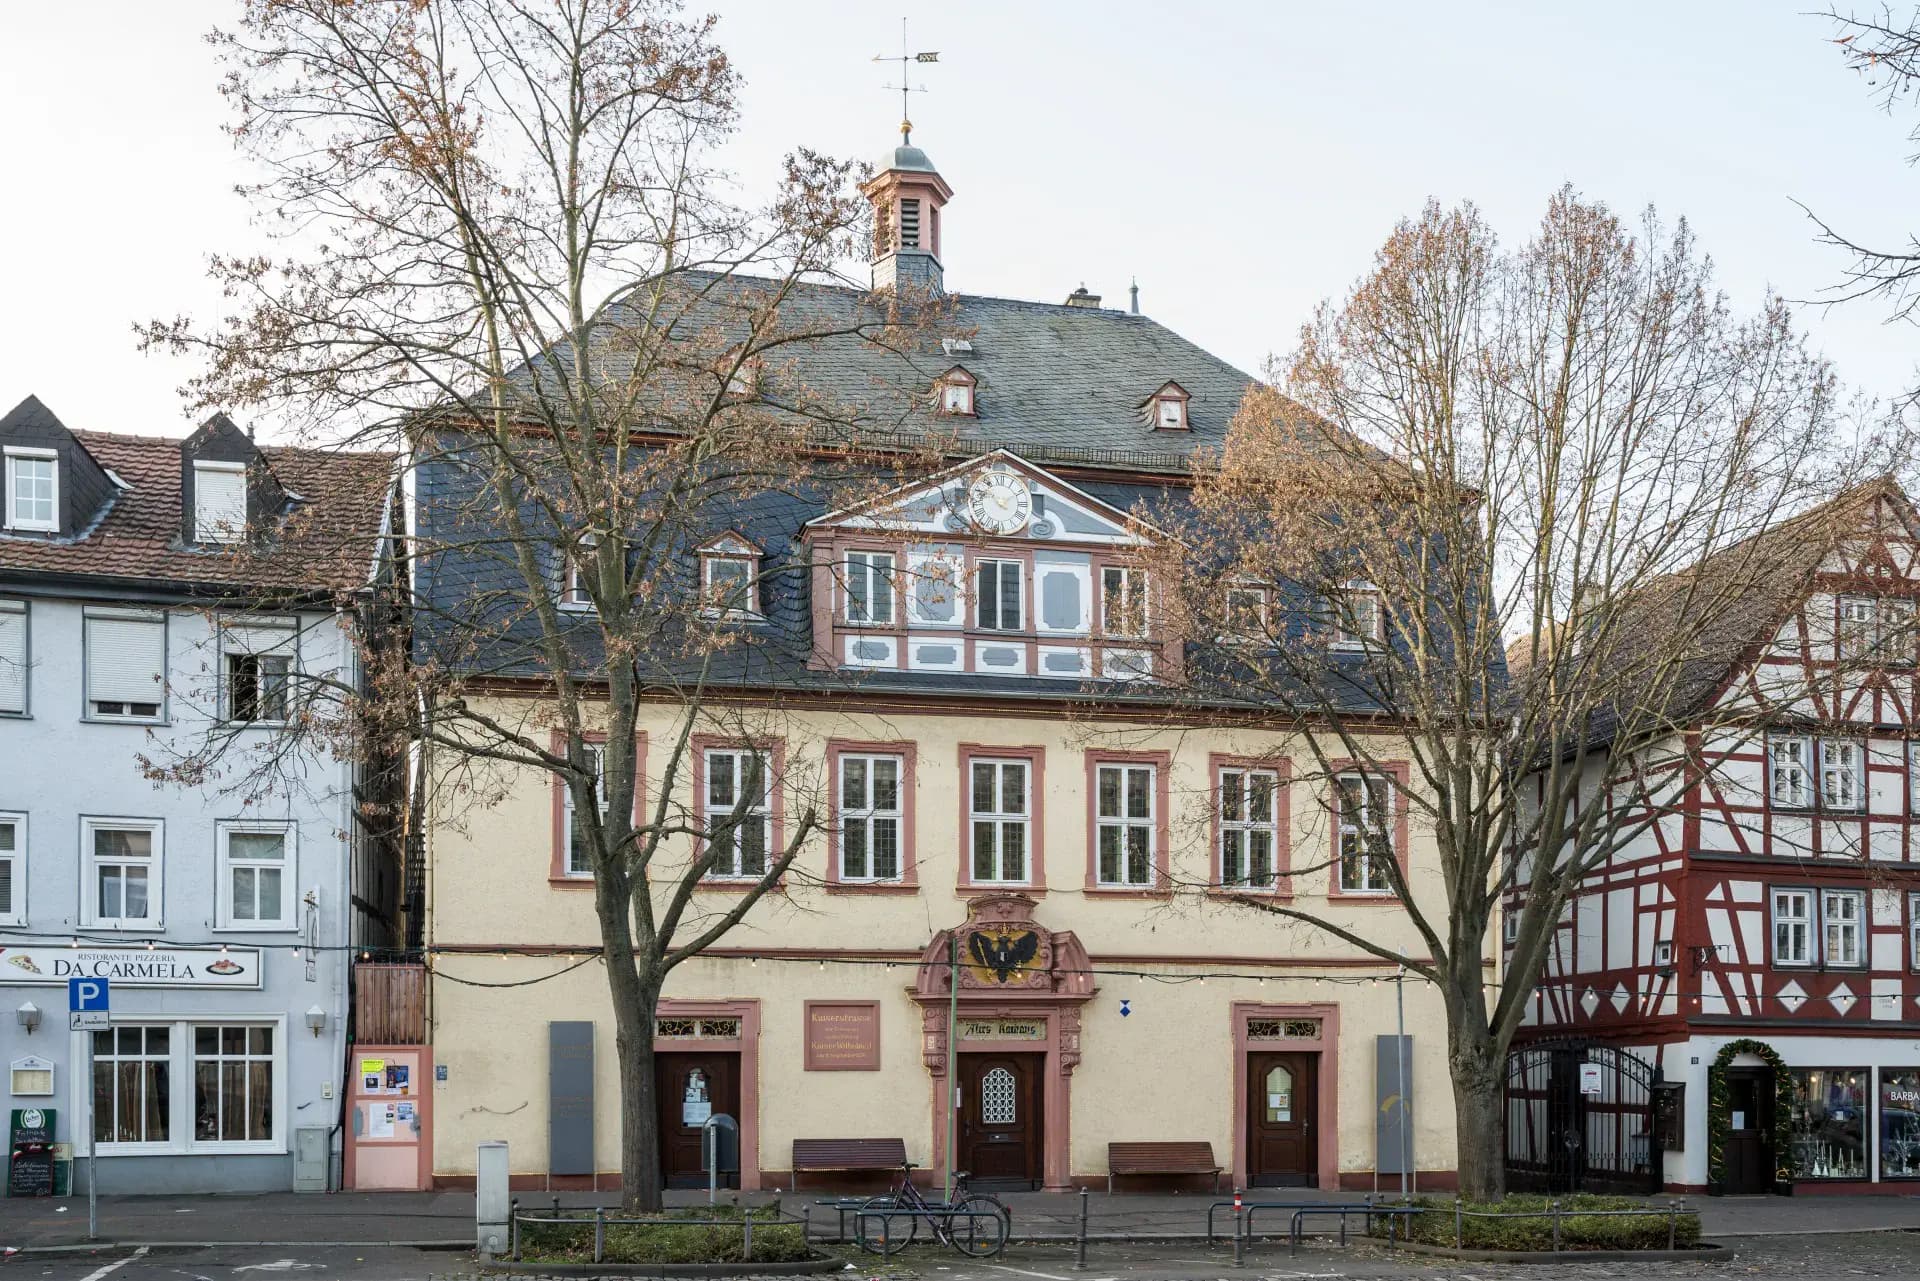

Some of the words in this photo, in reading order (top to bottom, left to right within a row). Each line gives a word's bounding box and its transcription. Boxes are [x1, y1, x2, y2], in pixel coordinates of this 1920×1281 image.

[78, 953, 130, 962] RISTORANTE
[135, 954, 176, 963] PIZZERIA
[54, 959, 84, 977] DA
[93, 960, 195, 979] CARMELA
[78, 982, 100, 1010] P
[1890, 1091, 1920, 1101] BARBA
